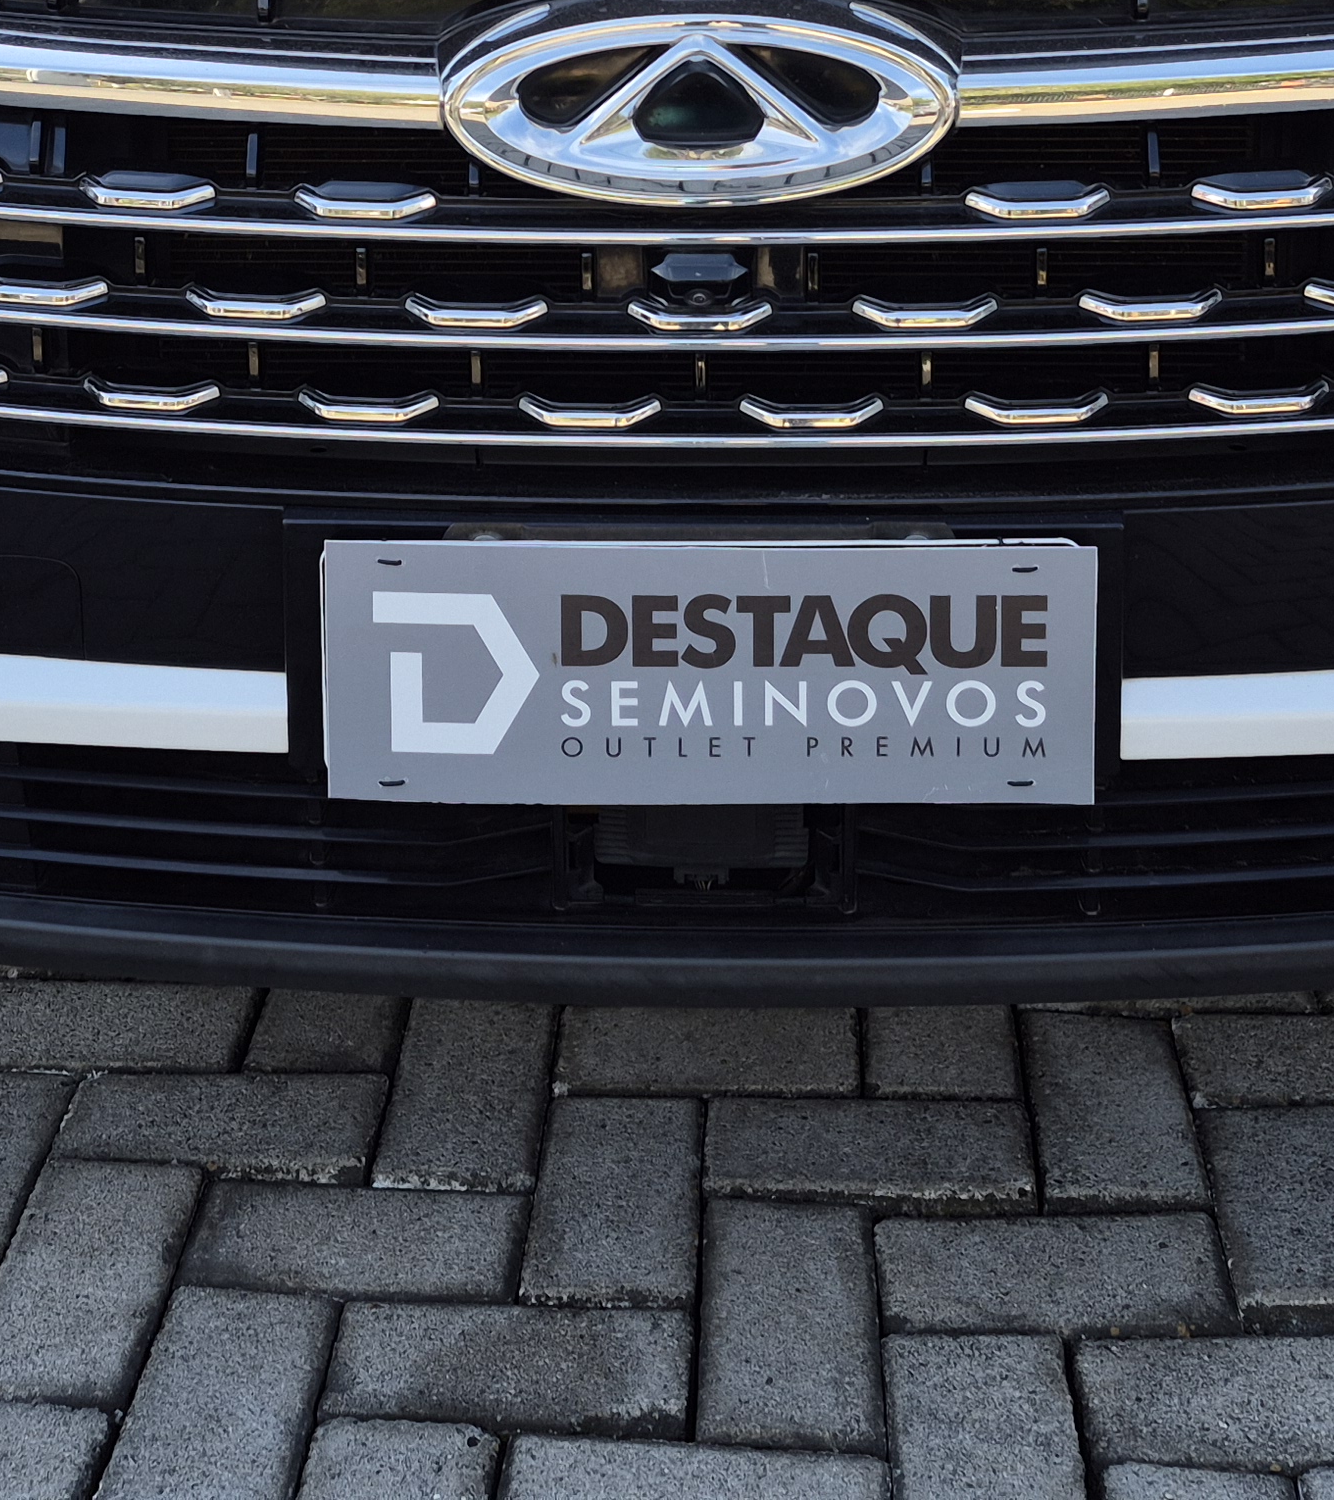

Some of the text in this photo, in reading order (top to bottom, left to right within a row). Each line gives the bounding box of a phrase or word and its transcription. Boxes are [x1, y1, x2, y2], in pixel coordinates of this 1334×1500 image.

[560, 594, 1049, 675] DESTAQUE
[560, 680, 1047, 728] SEMINOVOS
[560, 736, 1048, 758] OUTLET PREMIUM
